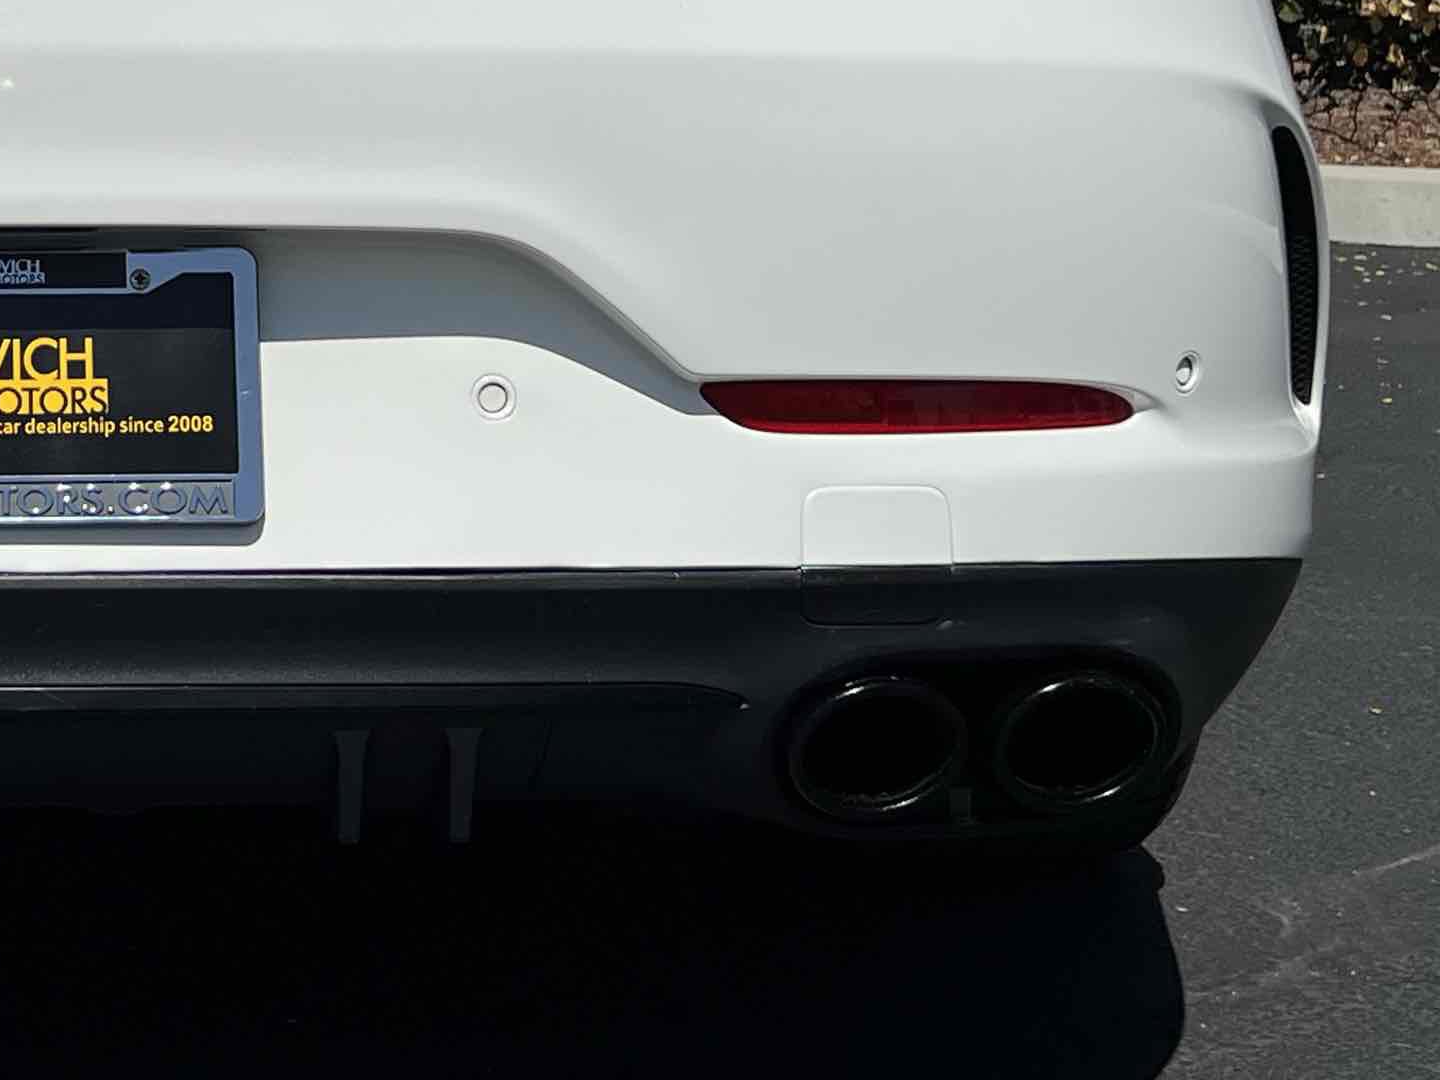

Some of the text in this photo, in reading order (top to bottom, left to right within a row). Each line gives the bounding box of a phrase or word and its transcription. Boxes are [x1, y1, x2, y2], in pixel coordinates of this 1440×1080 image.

[24, 415, 117, 438] dealership
[118, 414, 165, 433] since
[167, 414, 215, 433] 2008
